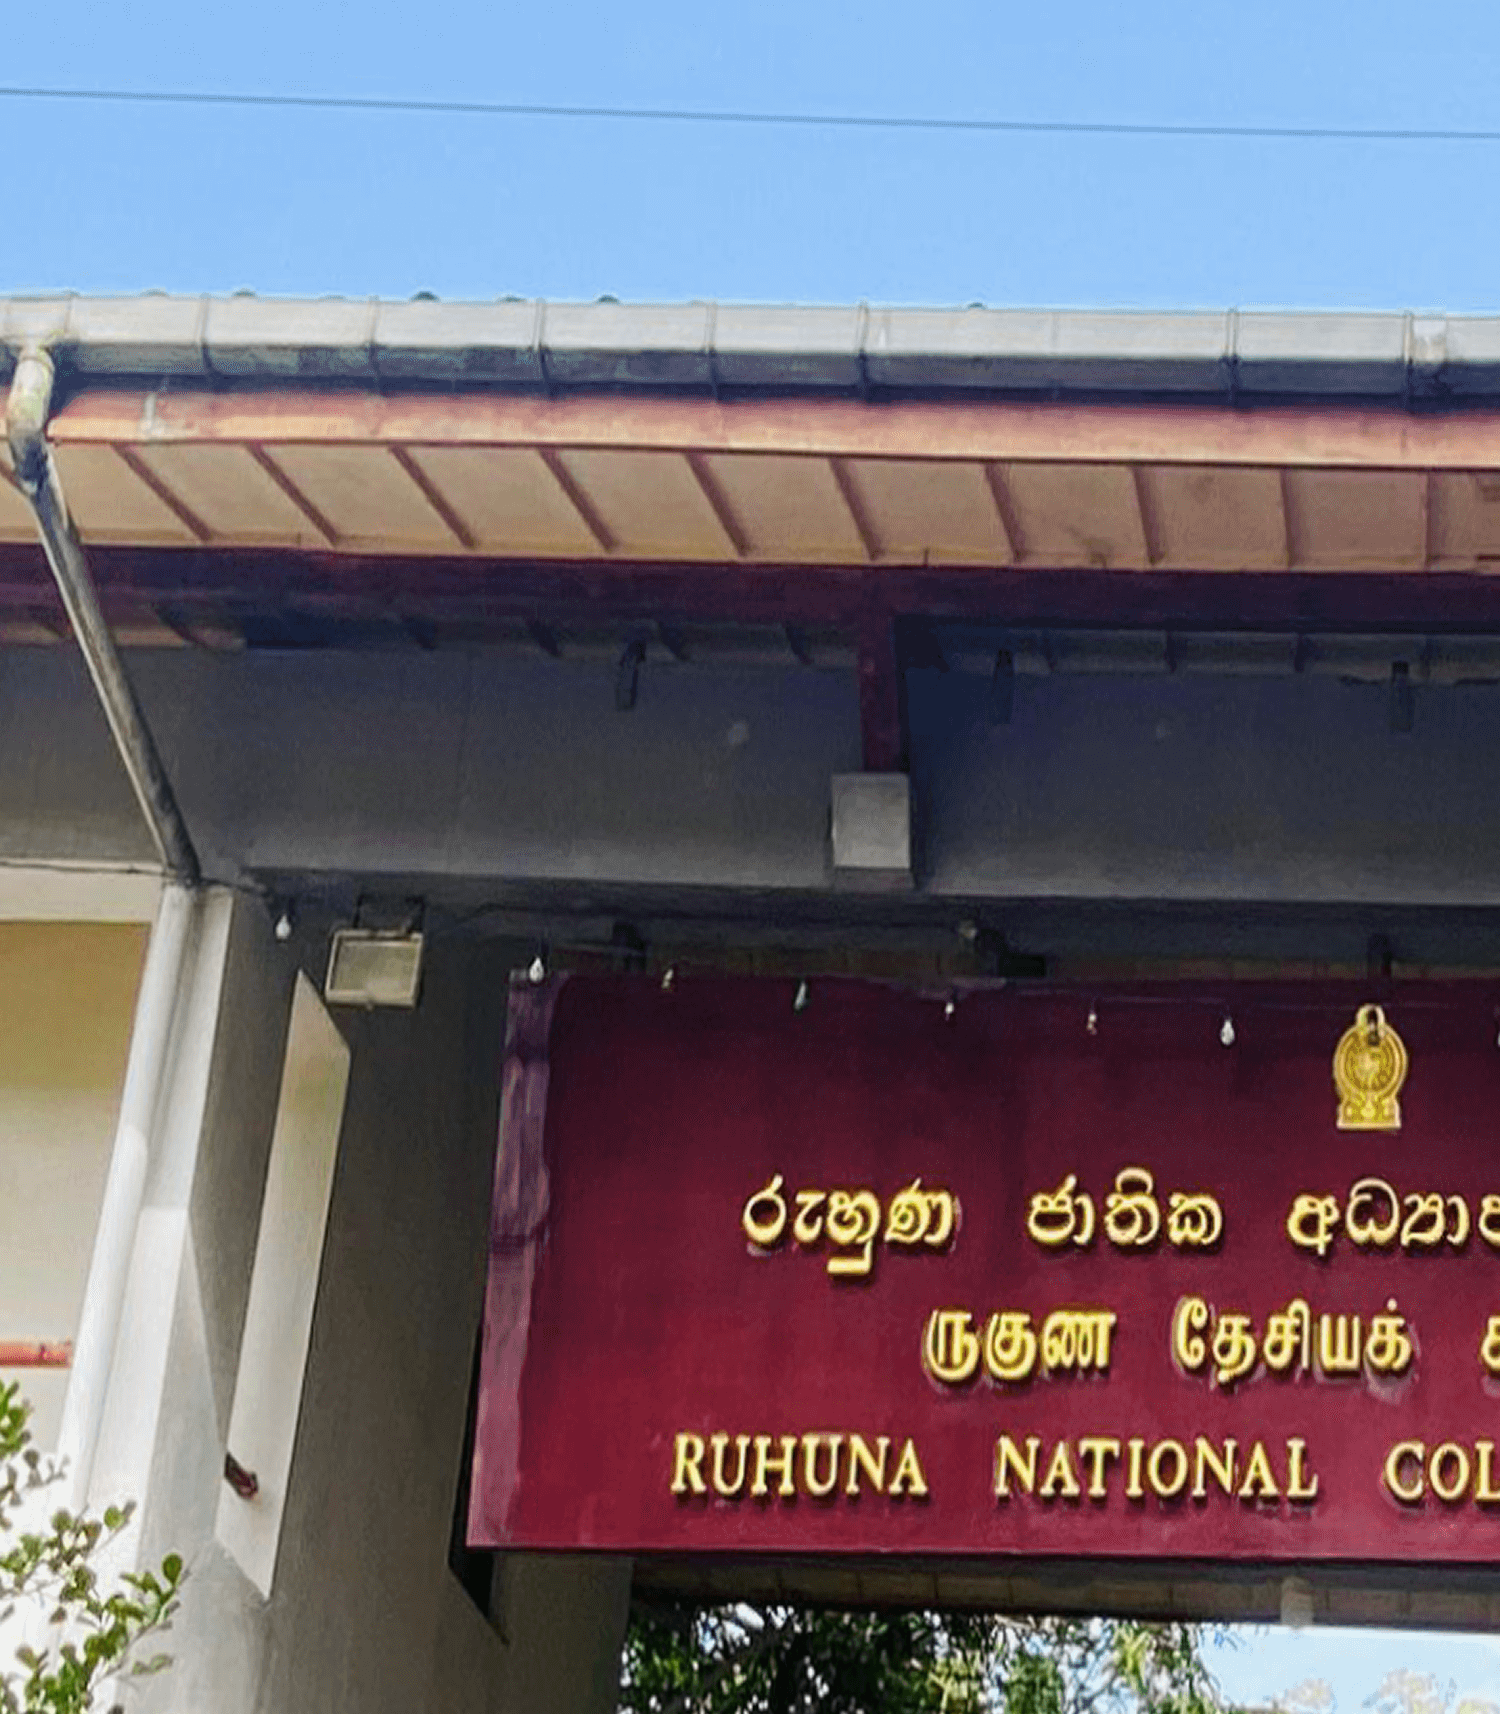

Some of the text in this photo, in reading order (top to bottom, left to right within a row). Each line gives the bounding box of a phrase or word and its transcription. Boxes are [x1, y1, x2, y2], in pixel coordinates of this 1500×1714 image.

[741, 1173, 954, 1274] රුහුණ
[1026, 1166, 1224, 1246] ජාතික
[1176, 1296, 1413, 1384] தேசியக்
[669, 1432, 929, 1496] RUHUNA
[993, 1434, 1319, 1498] NATIONAL
